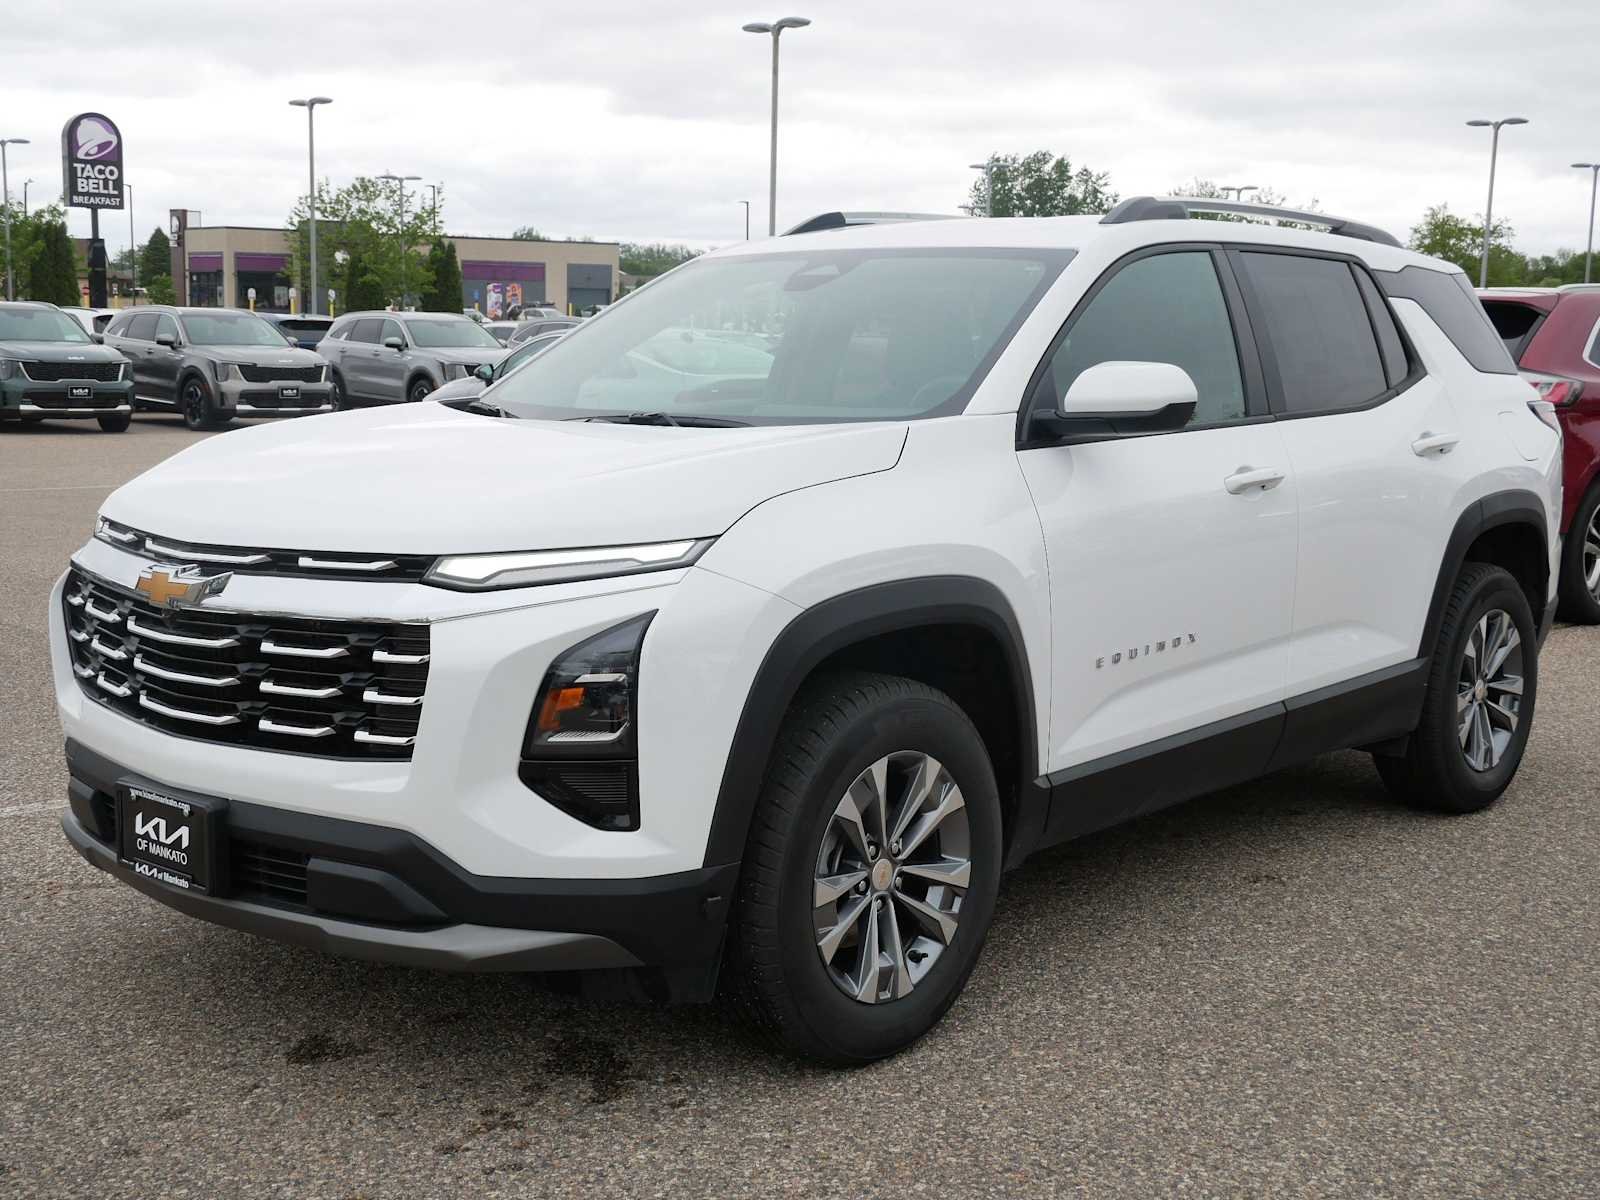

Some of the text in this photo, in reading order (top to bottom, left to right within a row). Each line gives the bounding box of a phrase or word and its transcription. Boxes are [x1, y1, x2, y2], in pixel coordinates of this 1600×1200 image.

[73, 163, 118, 180] TACO
[78, 178, 118, 194] BELL
[73, 196, 120, 205] BREAKFAST
[1096, 634, 1195, 668] EQUINOX
[136, 812, 189, 849] KIA
[136, 838, 188, 865] OF MANKATO
[136, 862, 158, 878] KIA
[164, 872, 188, 888] Mankato
